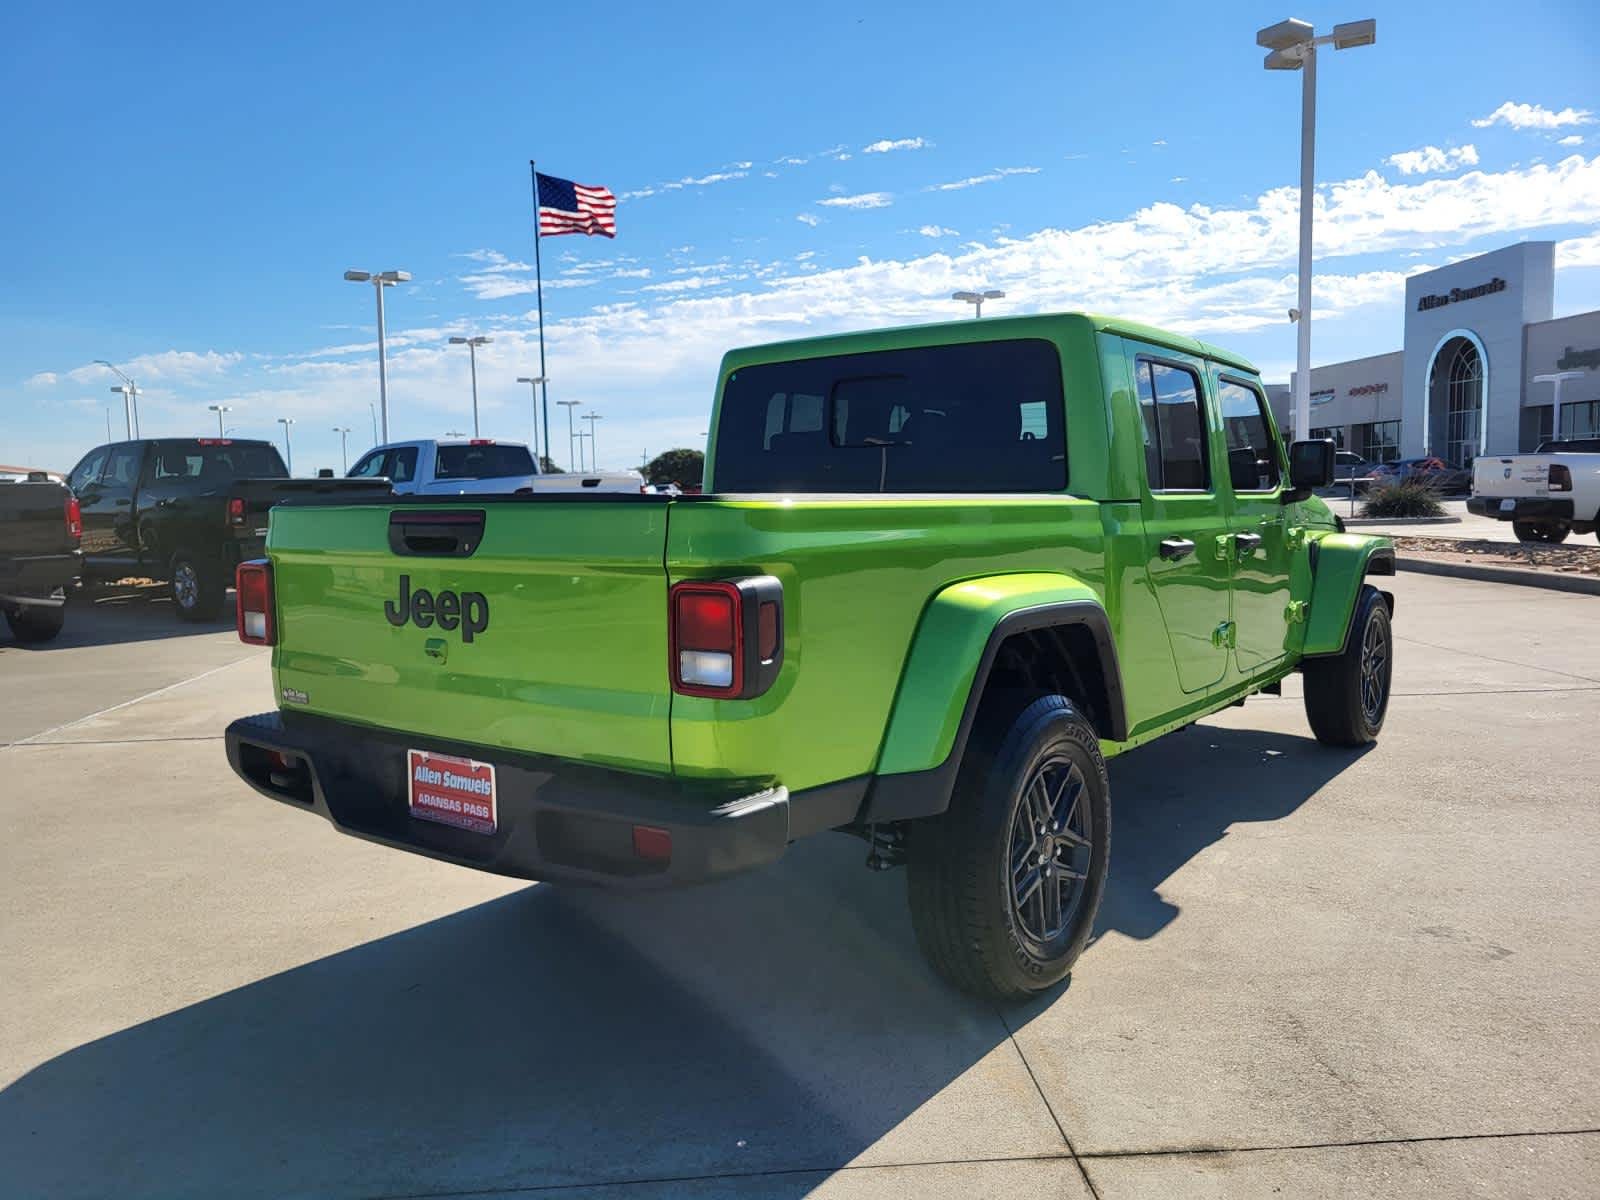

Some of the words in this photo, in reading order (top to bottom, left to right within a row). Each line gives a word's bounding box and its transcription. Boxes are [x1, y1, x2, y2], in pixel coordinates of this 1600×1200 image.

[383, 574, 489, 643] Jeep
[414, 765, 442, 785] Allen
[443, 770, 491, 796] Samuels
[417, 792, 462, 813] ARANSAS
[463, 801, 489, 818] PASS
